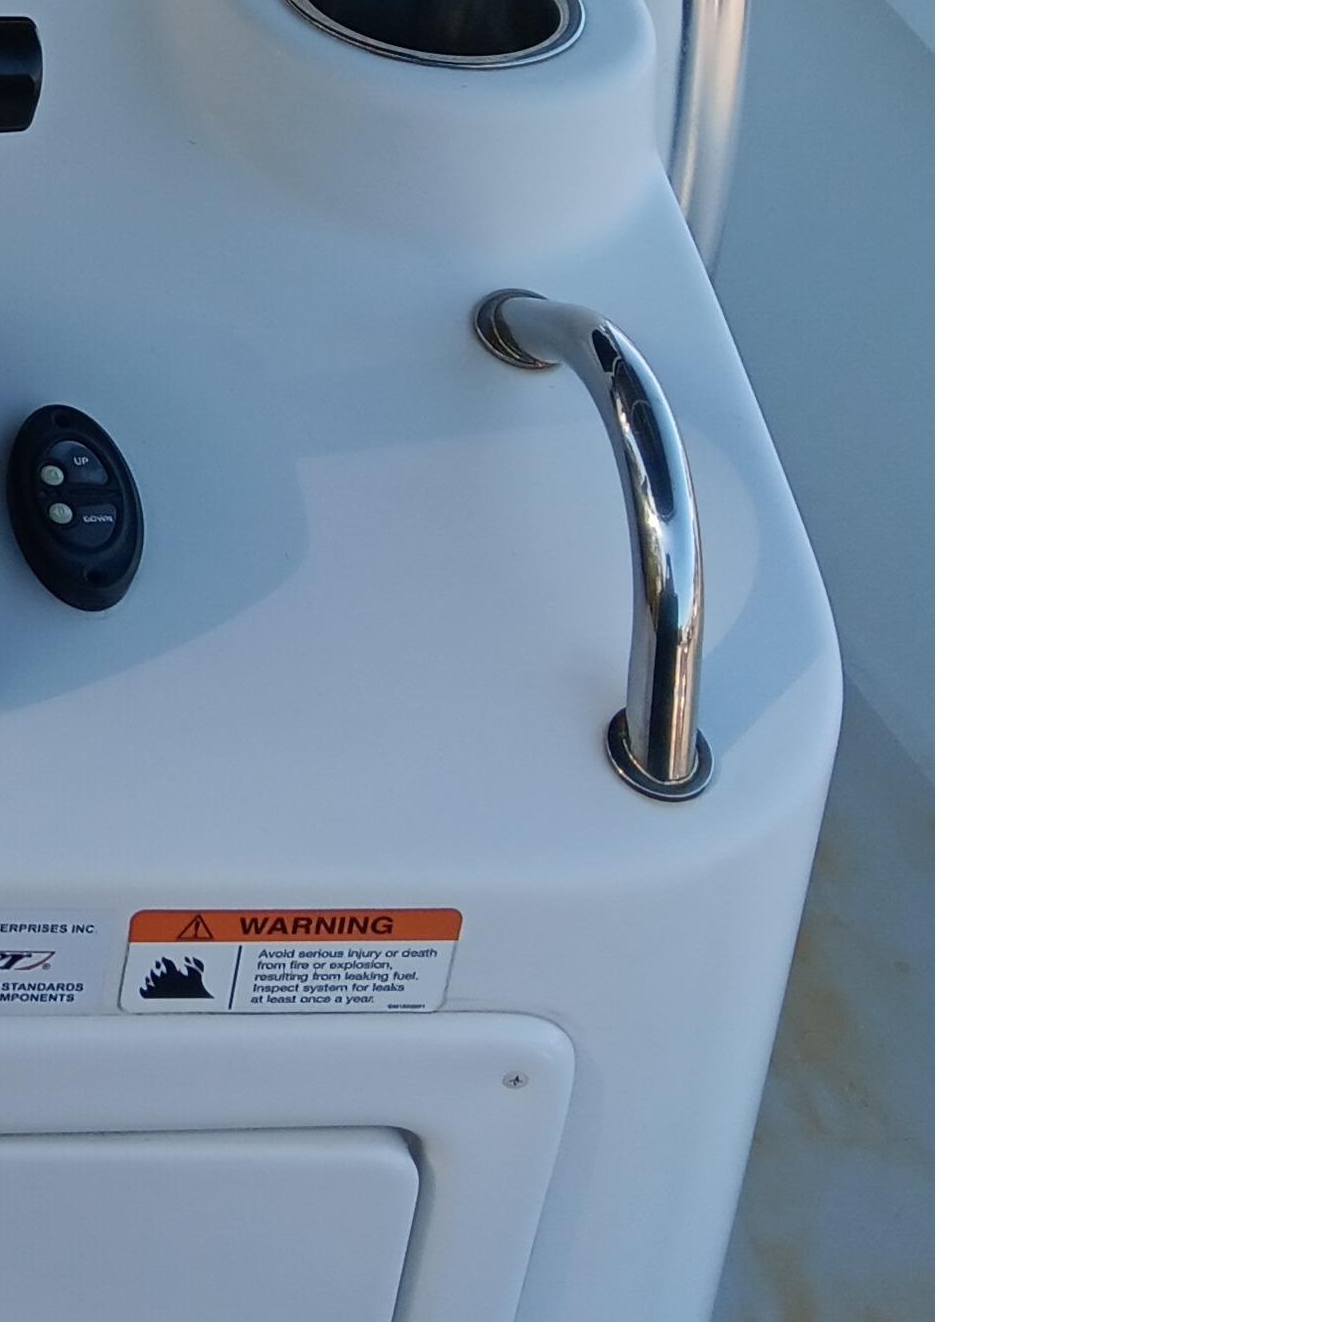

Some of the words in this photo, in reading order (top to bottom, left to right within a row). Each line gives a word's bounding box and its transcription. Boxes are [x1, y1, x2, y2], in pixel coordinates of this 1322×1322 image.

[73, 456, 89, 466] UP
[239, 916, 394, 935] WARNING
[258, 948, 295, 959] Avoid
[298, 949, 344, 959] serious
[347, 948, 382, 960] injury
[385, 949, 399, 958] or
[402, 948, 438, 958] death
[257, 960, 286, 971] from
[290, 960, 309, 970] fire
[313, 961, 325, 970] or
[329, 960, 393, 971] explosion,
[254, 971, 309, 983] resulting
[312, 971, 341, 981] from
[345, 971, 389, 983] leaking
[393, 971, 419, 981] fuel.
[1, 982, 84, 992] STANDARDS
[252, 982, 299, 995] Inspect
[303, 983, 348, 994] system
[352, 982, 370, 992] for
[372, 982, 405, 992] leaks
[250, 994, 263, 1004] at
[266, 994, 296, 1004] least
[300, 995, 331, 1004] once
[335, 995, 343, 1004] a
